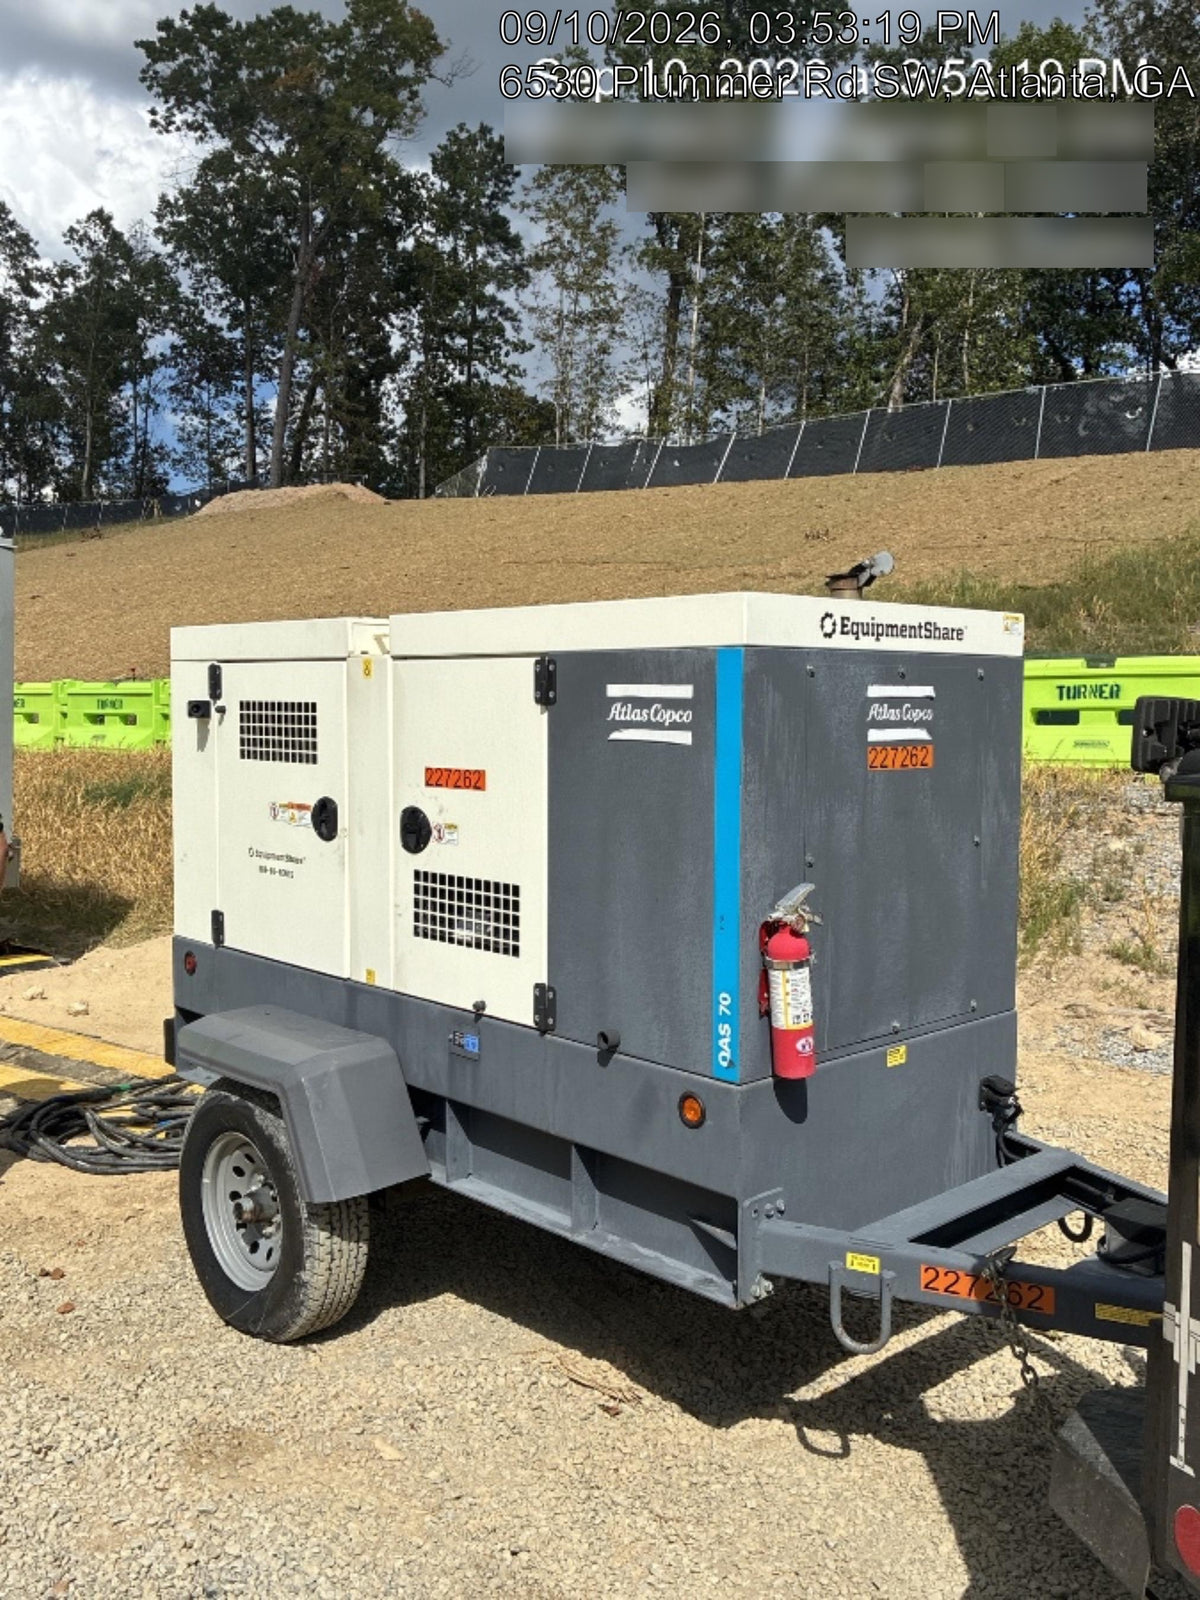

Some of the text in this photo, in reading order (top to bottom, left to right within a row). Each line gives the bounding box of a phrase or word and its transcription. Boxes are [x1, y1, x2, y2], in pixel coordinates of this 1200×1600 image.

[840, 616, 965, 641] EquipmentShare
[1056, 683, 1121, 701] TURNER
[606, 702, 693, 726] Atlas Copco
[866, 703, 934, 724] Atlas Copco
[869, 746, 930, 769] 227262
[424, 767, 483, 790] 227262
[719, 992, 732, 1016] 70
